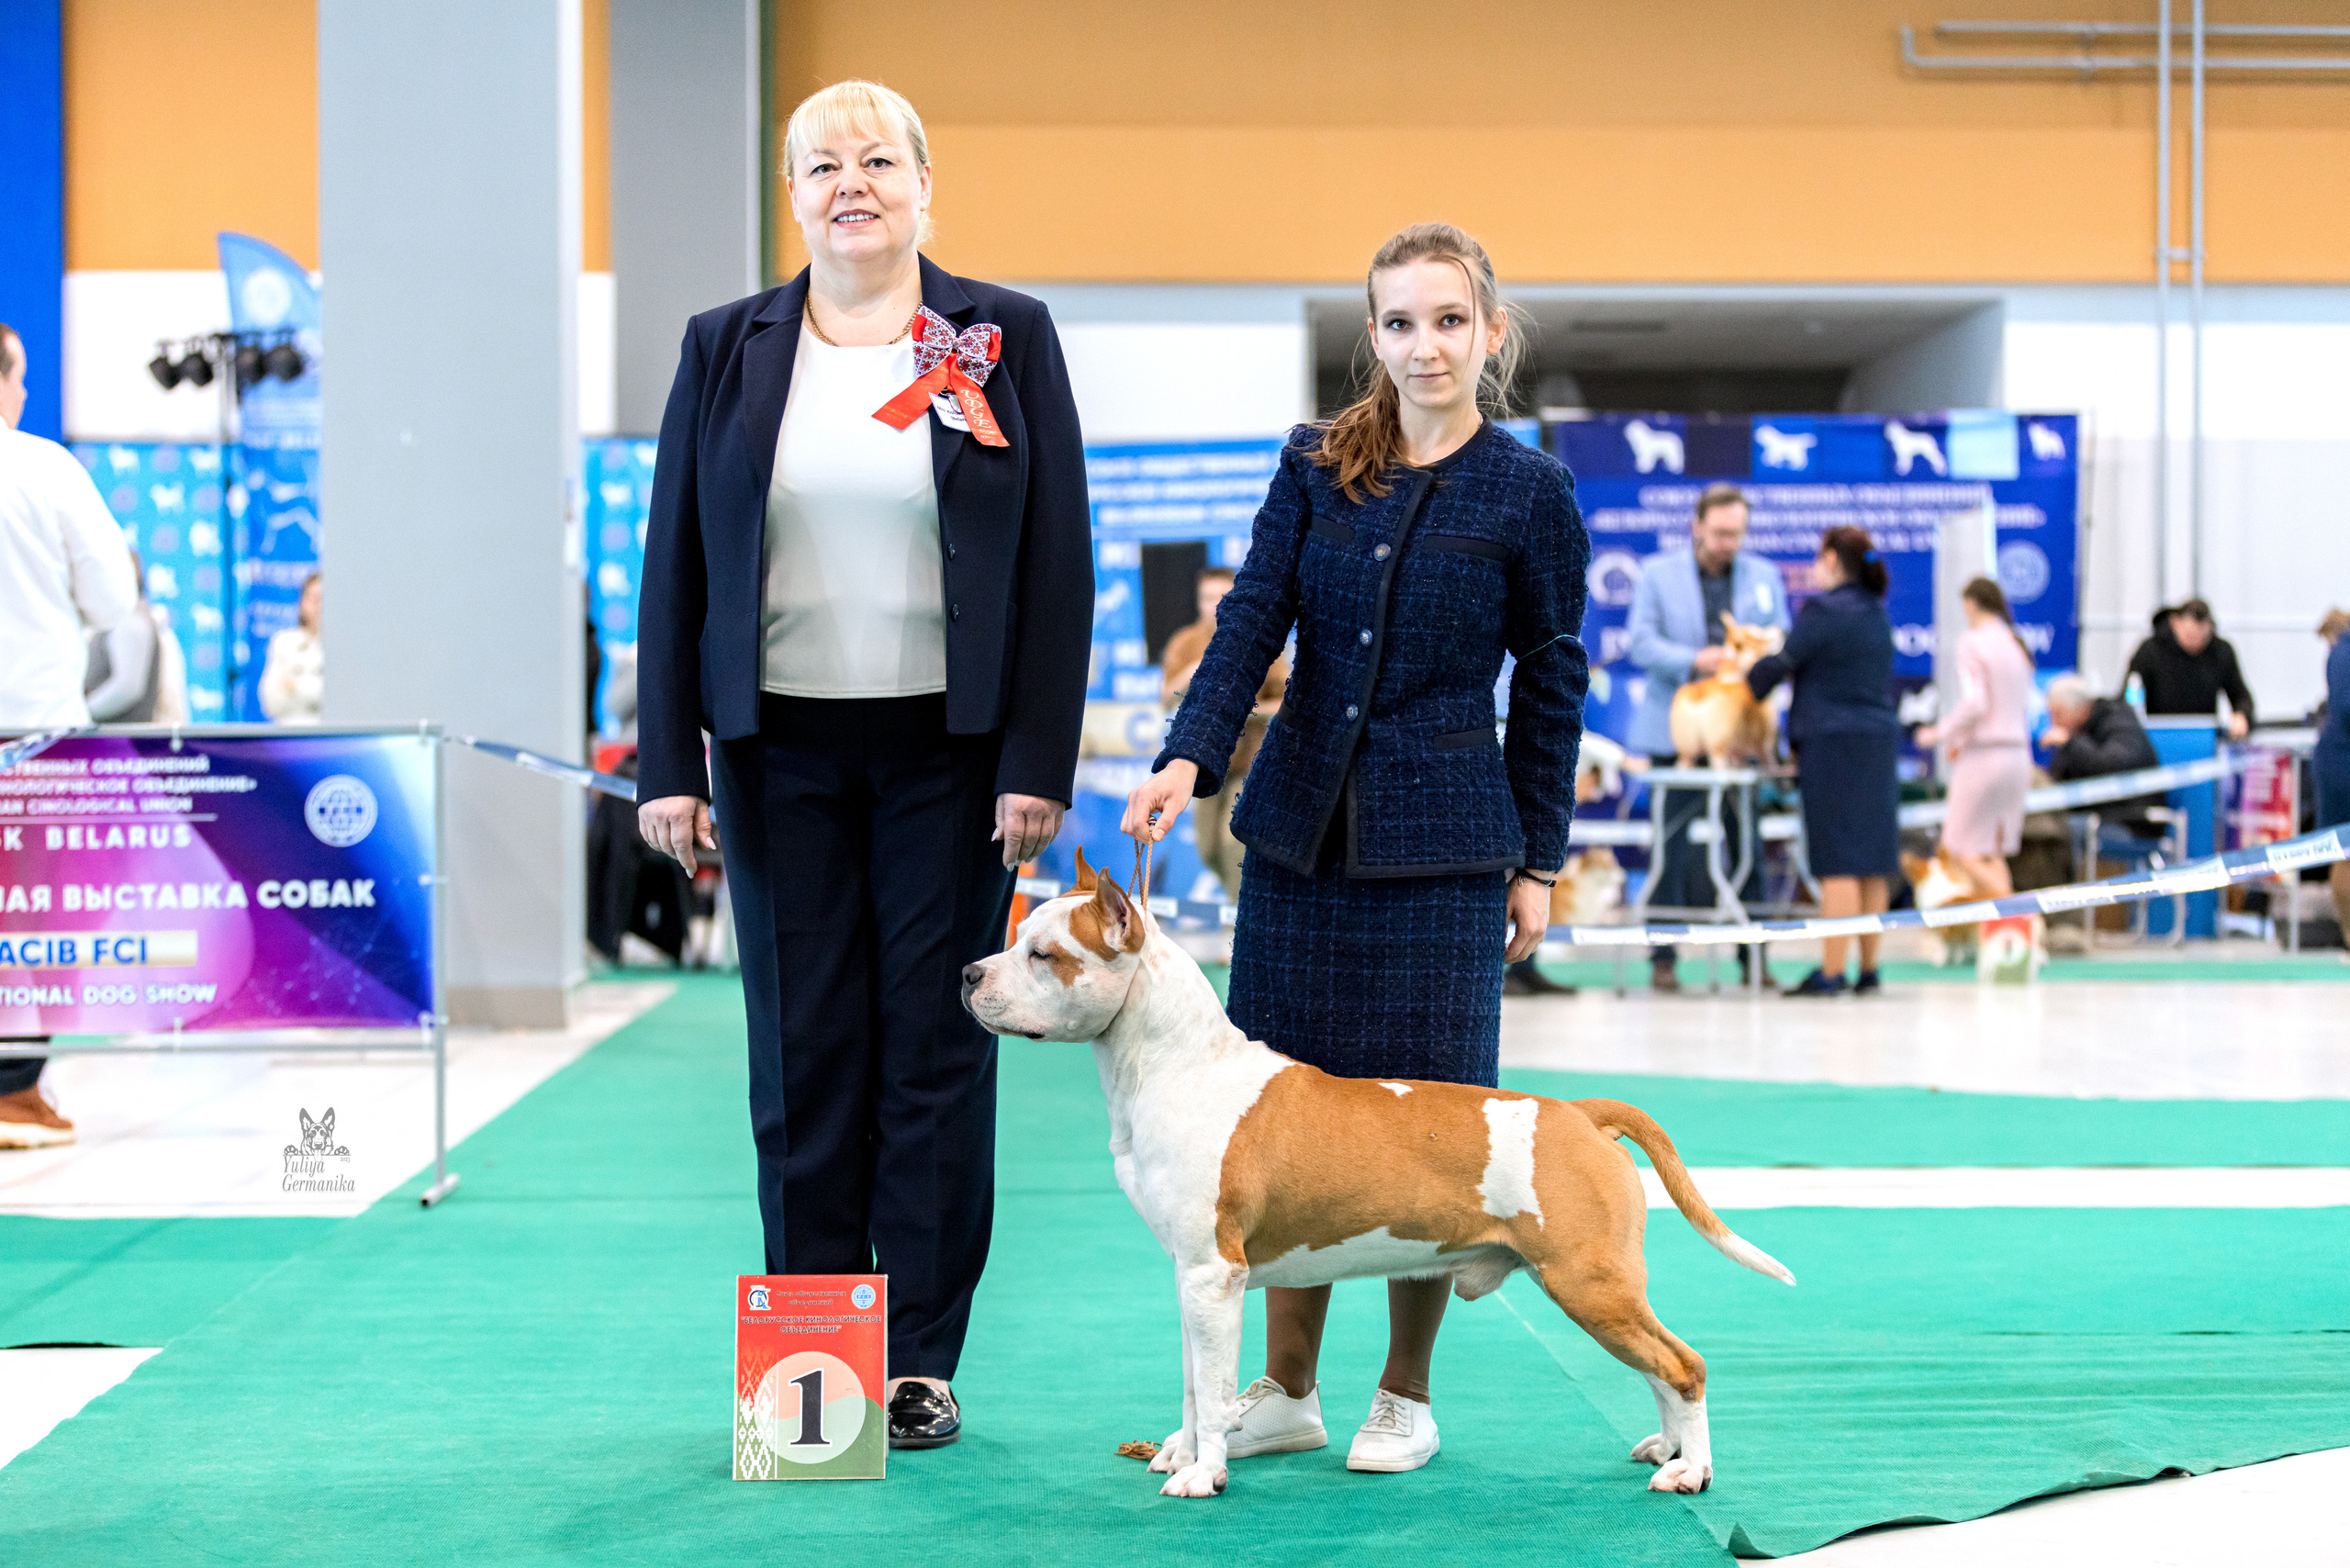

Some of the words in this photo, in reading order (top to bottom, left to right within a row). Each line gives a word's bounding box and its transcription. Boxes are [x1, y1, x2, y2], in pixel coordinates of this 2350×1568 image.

[960, 382, 992, 429] UDGE
[140, 796, 193, 813] UNION
[0, 825, 24, 851] K
[46, 824, 192, 850] BELARUS
[63, 881, 249, 913] ВЫСТАВКА
[256, 879, 376, 909] СОБАК
[93, 937, 148, 965] FCI
[84, 984, 138, 1005] DOG
[145, 982, 218, 1004] SHOW
[788, 1298, 834, 1307] объединений
[795, 1289, 846, 1298] общественных
[741, 1316, 804, 1325] "БЕЛОРУССКОЕ
[805, 1315, 881, 1324] КИНОЛОГИЧЕСКОЕ
[779, 1325, 843, 1334] ОБЪЕДИНЕНИЕ"
[788, 1368, 833, 1447] 1
